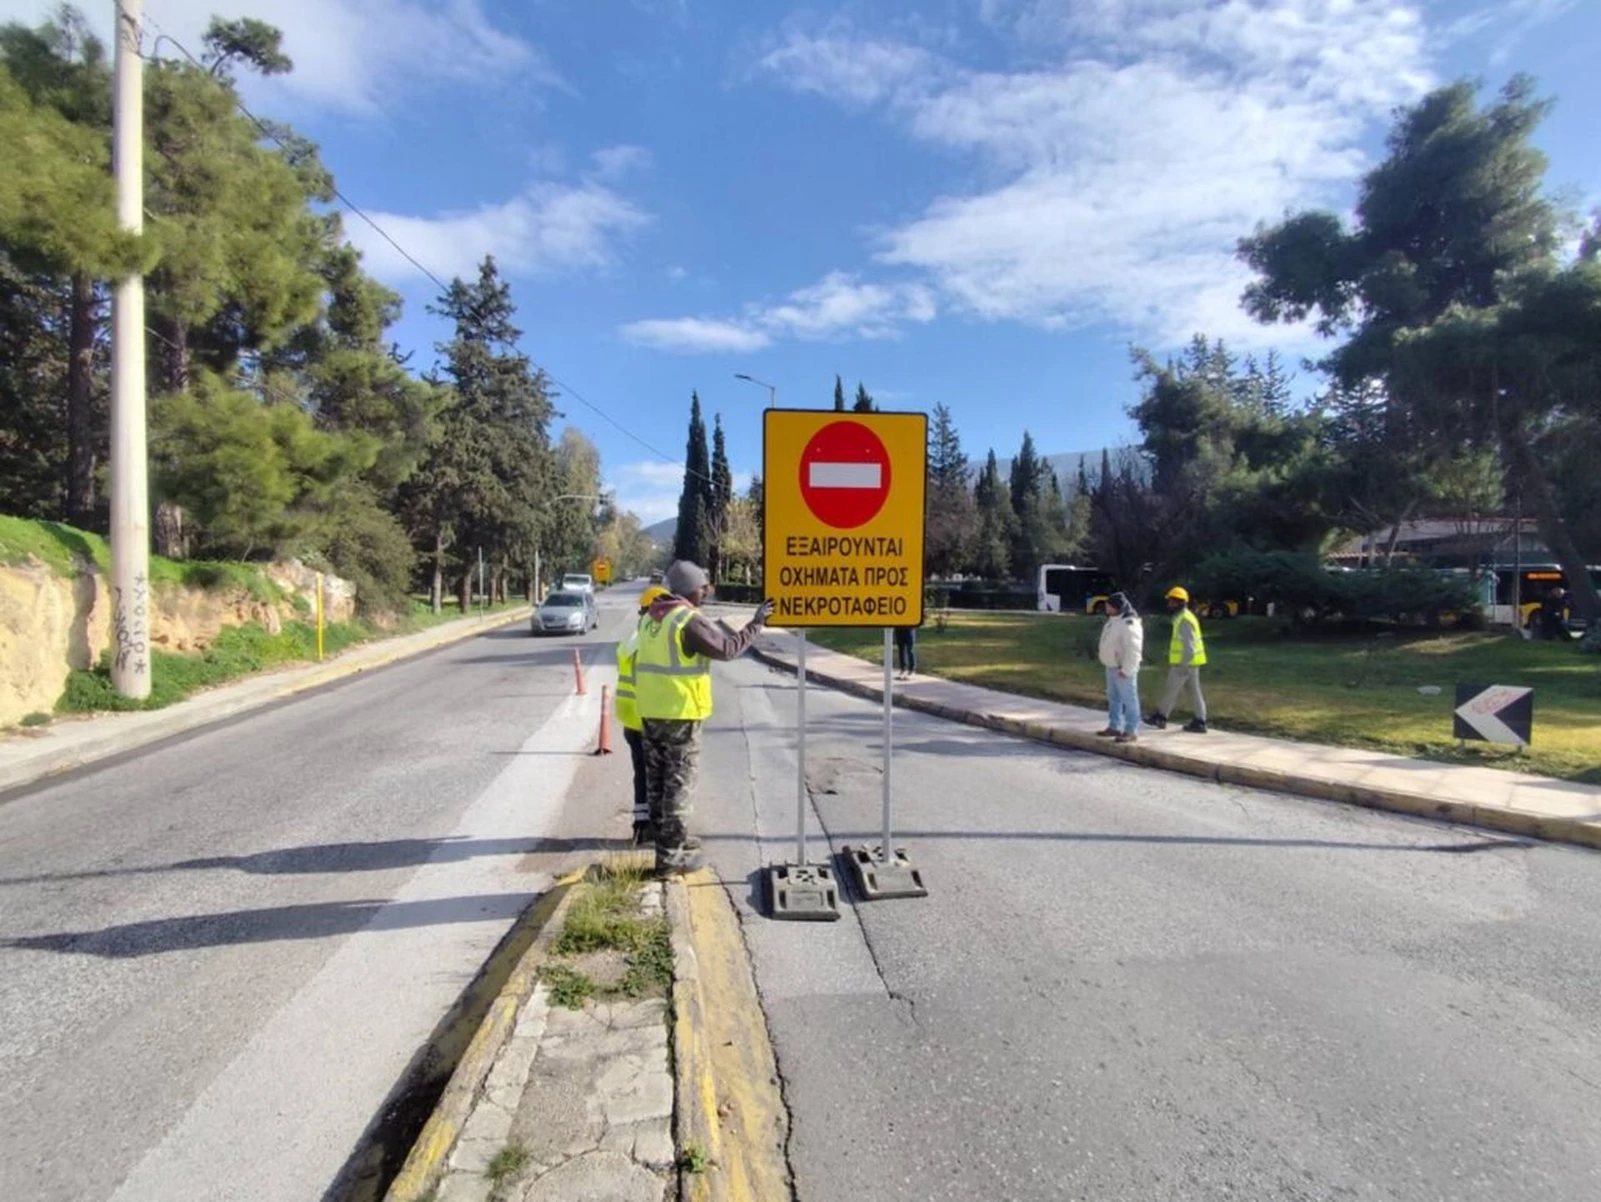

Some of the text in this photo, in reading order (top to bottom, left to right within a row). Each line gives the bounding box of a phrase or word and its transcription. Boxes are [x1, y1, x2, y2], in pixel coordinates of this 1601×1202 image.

[786, 536, 903, 557] ΕΞΑΙΡΟΥΝΤΑΙ
[780, 566, 908, 587] ΟΧΗΜΑΤΑ ΠΡΟΣ
[780, 596, 906, 616] ΝΕΚΡΟΤΑΦΕΙΟ
